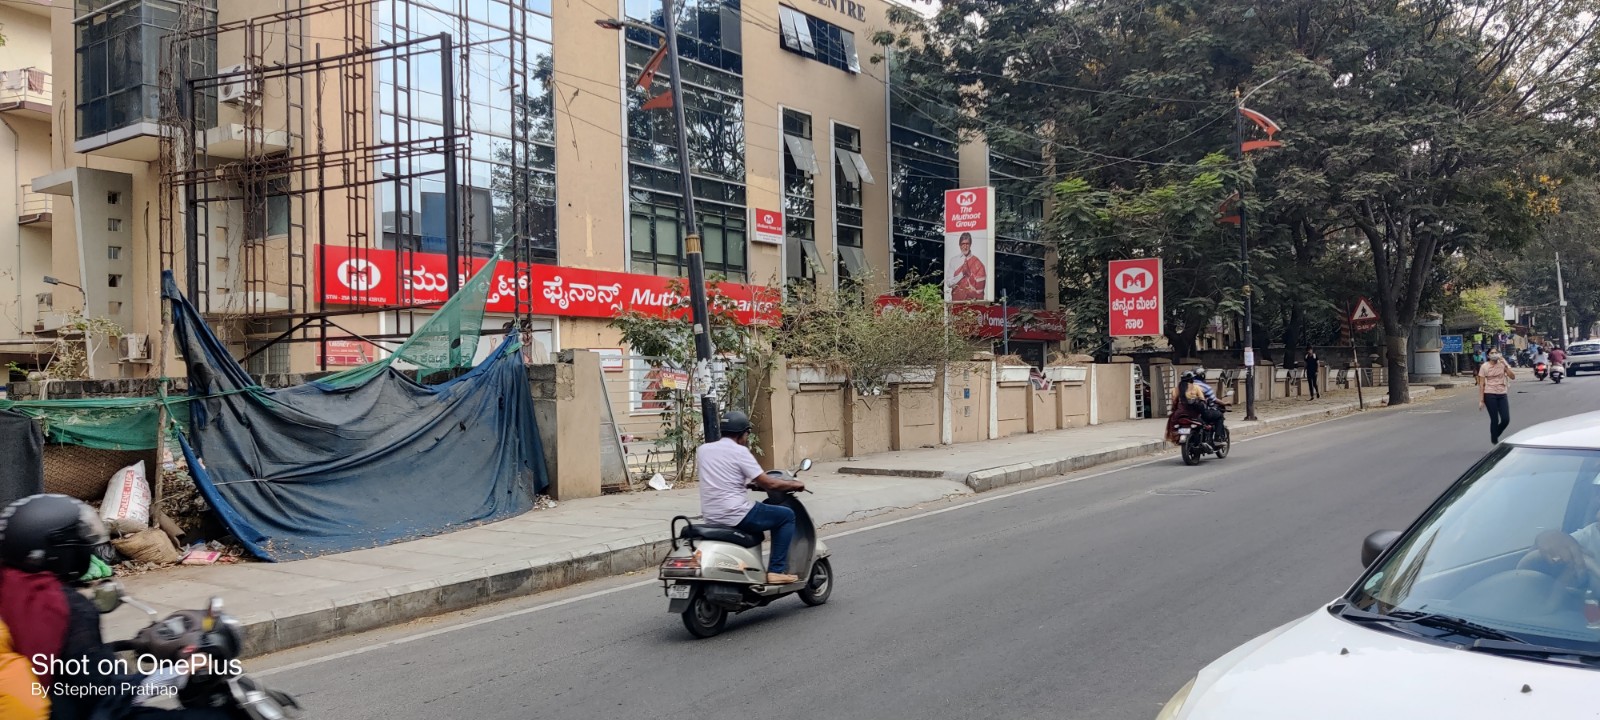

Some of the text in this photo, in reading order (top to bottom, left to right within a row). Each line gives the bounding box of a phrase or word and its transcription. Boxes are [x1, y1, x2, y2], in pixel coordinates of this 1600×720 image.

[810, 0, 866, 23] NTRE
[960, 206, 973, 214] The
[951, 212, 982, 221] Muthoot
[955, 220, 977, 228] Group
[630, 288, 709, 308] Mutho
[1125, 318, 1144, 330] ಸಾಲ
